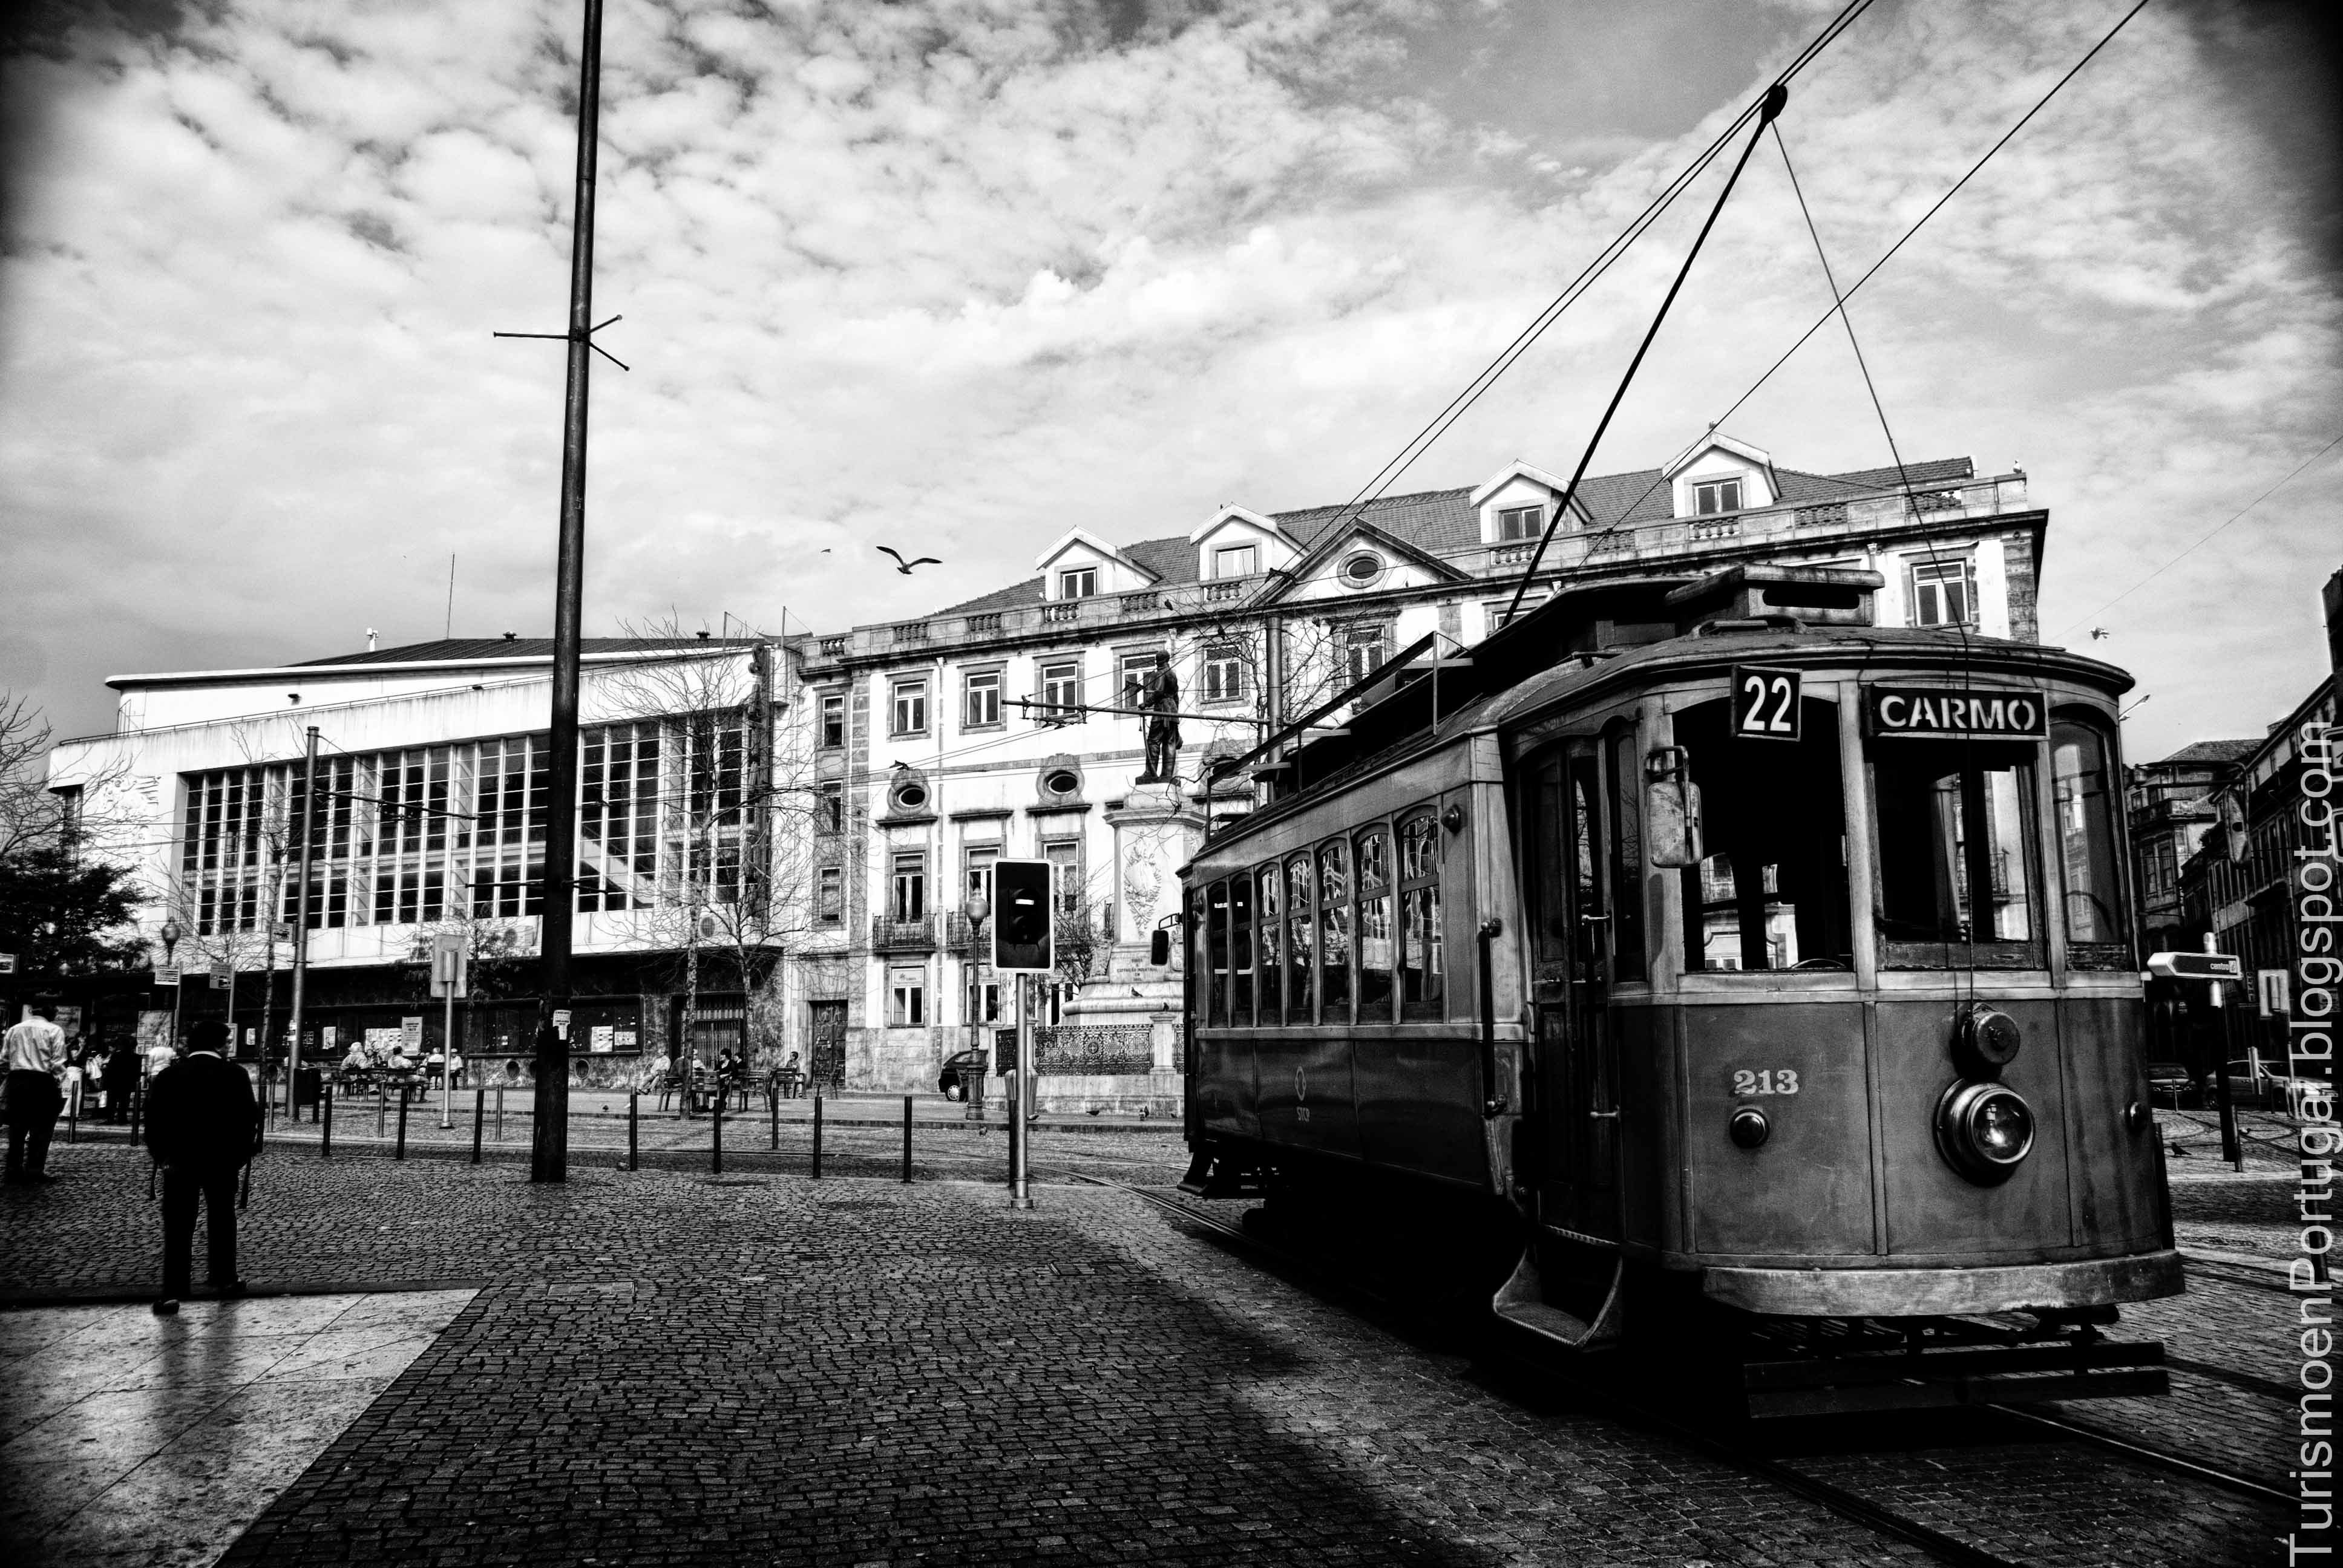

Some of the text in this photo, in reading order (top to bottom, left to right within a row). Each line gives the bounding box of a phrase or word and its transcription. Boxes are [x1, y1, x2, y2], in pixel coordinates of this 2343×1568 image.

[1743, 675, 1792, 732] 22
[1879, 694, 2037, 731] CARMO
[1734, 1069, 1799, 1095] 213
